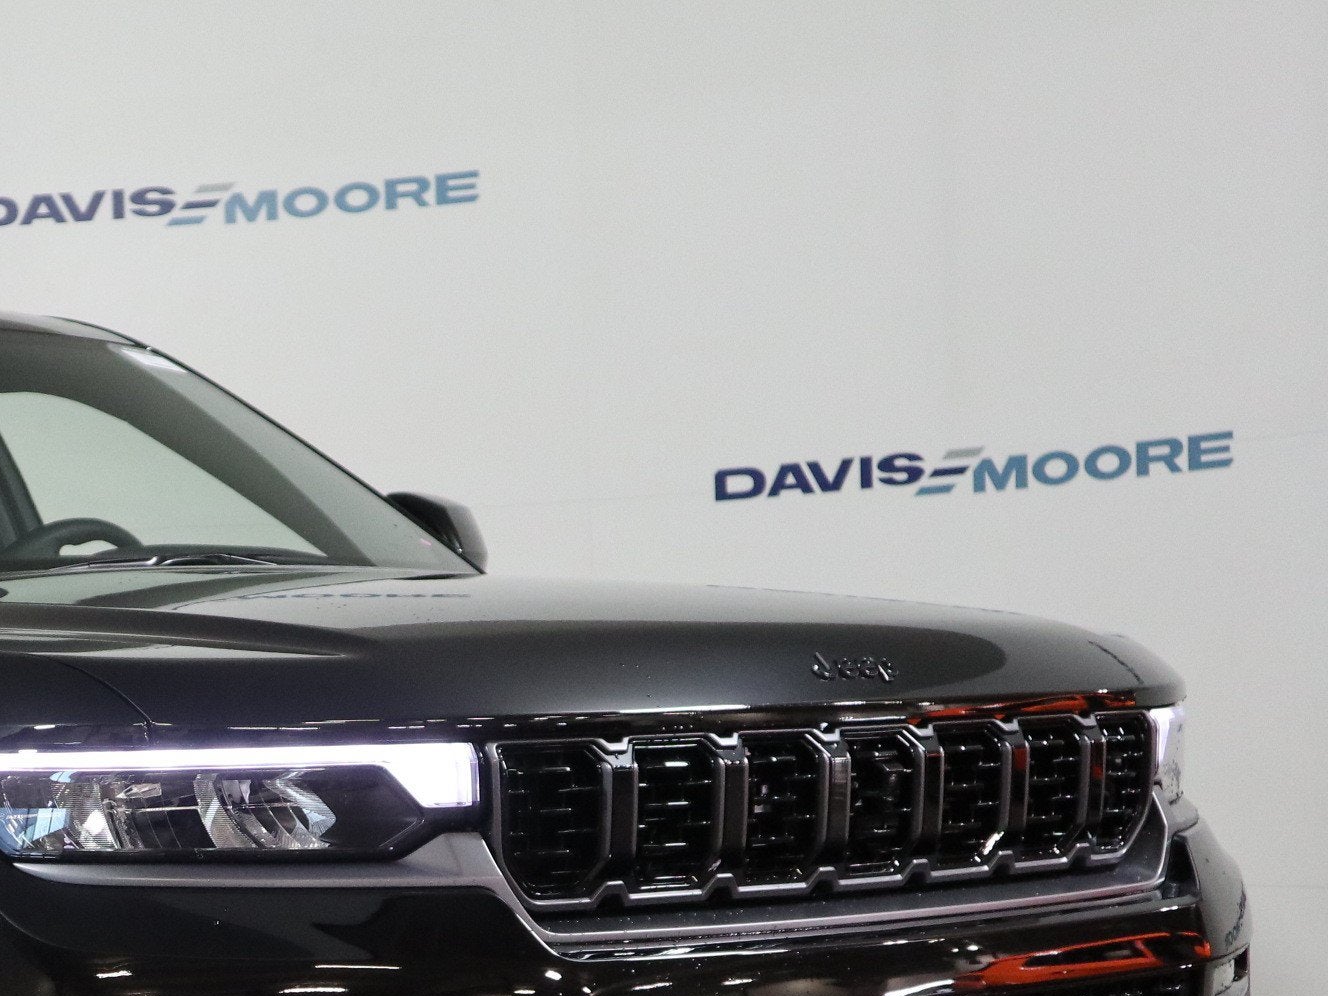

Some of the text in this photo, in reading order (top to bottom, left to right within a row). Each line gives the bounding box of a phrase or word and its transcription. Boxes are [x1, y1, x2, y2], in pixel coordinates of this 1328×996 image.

[224, 169, 480, 226] MOORE
[714, 430, 1235, 502] DAVIS MOORE
